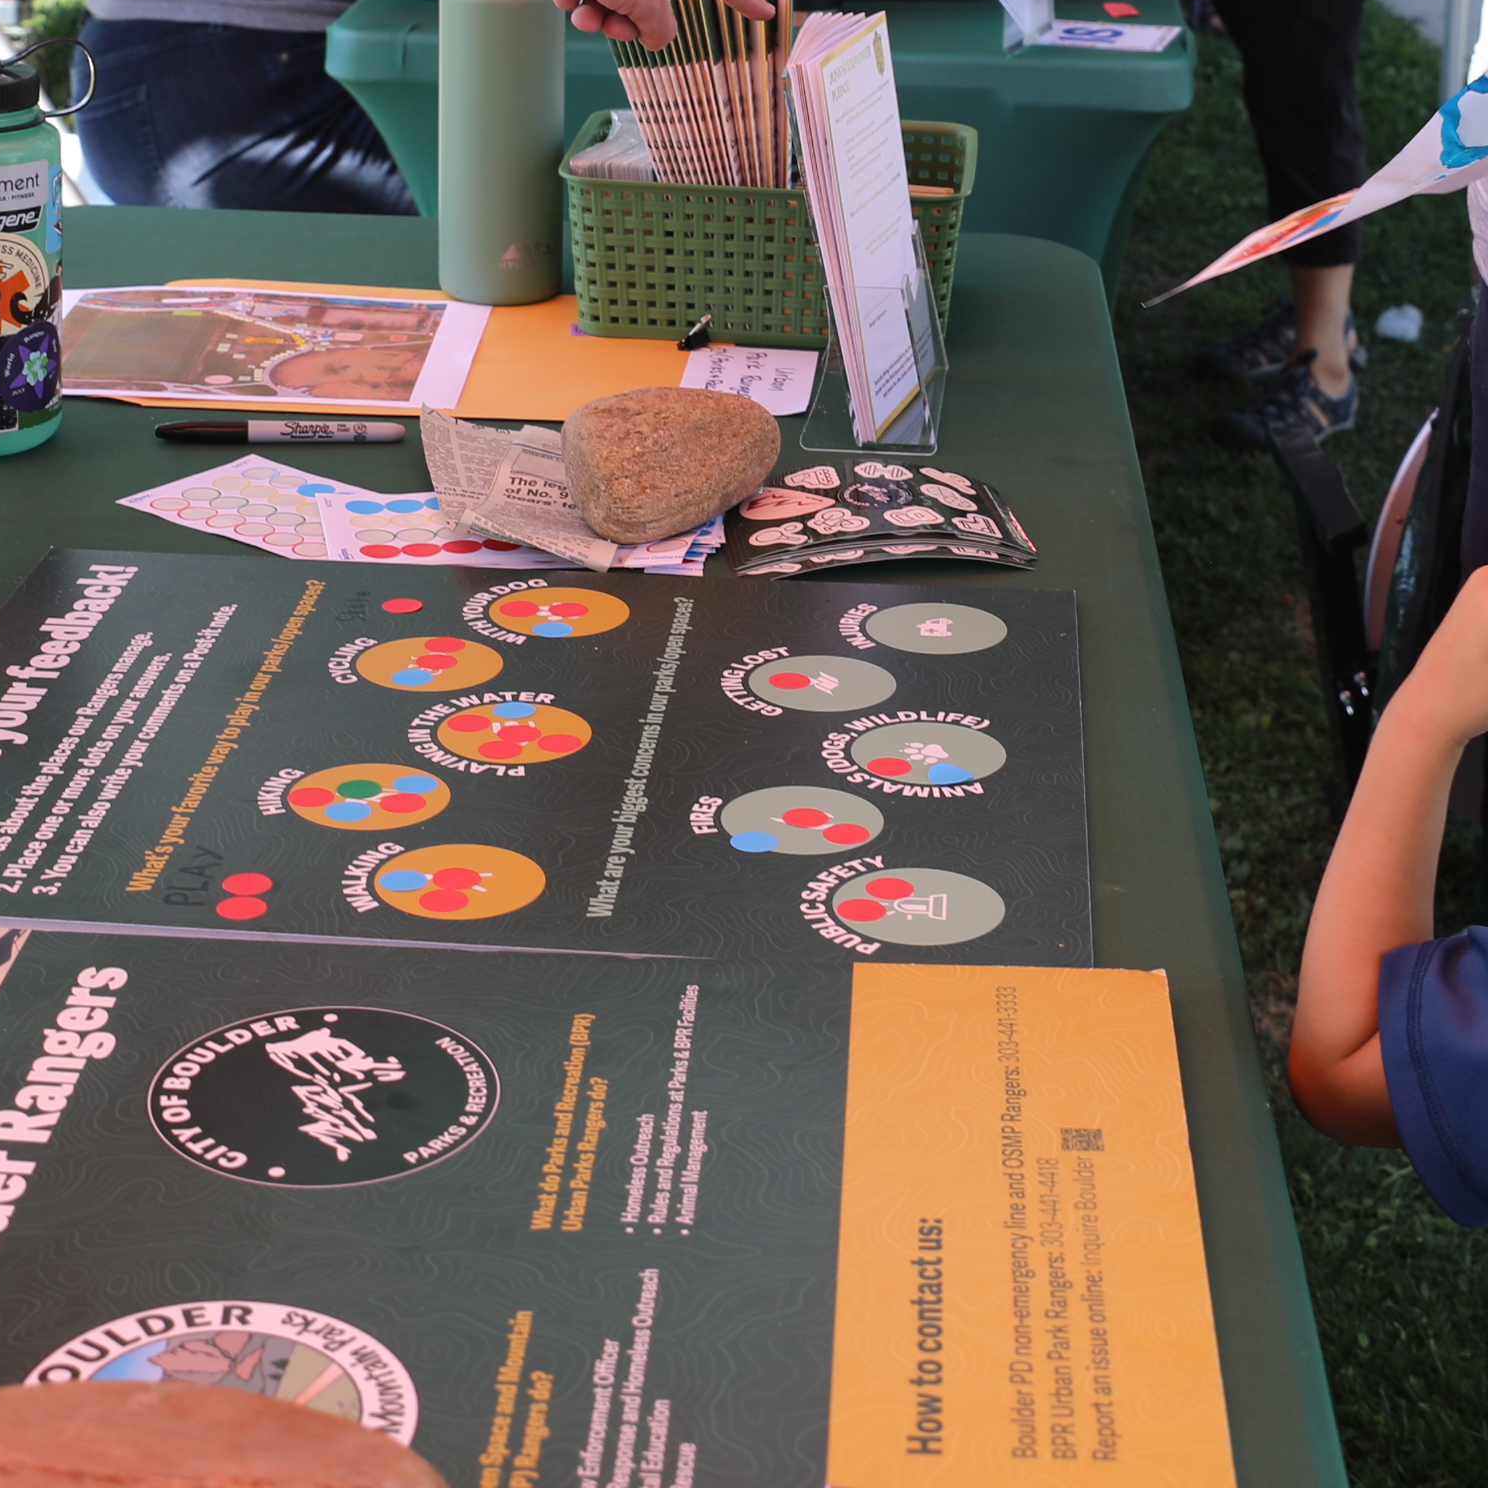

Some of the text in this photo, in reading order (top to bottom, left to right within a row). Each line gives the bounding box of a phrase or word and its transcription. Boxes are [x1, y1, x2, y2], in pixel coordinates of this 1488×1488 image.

[15, 248, 42, 290] MEDICINE
[505, 487, 570, 500] of No. 9
[509, 476, 538, 489] The
[462, 592, 498, 621] YOUR
[489, 578, 548, 596] DOG
[5, 563, 139, 679] feedback!
[468, 619, 527, 645] WITH
[838, 603, 878, 650] INJURIES
[111, 631, 154, 673] manage.
[328, 637, 379, 684] CYCLING
[75, 672, 124, 716] Rangers
[128, 652, 173, 699] answers.
[720, 646, 790, 717] GETTING LOST
[67, 715, 94, 736] our
[100, 724, 125, 740] on
[110, 698, 141, 725] your
[843, 710, 991, 733] WILDLIFE)
[31, 603, 238, 896] 3. You can also write your comments on a Post-it note.
[38, 736, 80, 775] places
[77, 740, 114, 767] dots
[124, 578, 326, 892] What's your favorite way to play in our parks/open spaces?
[407, 691, 556, 777] PLAYING IN THE WATER
[585, 596, 695, 918] What are your biggest concerns in our parks/open spaces?
[20, 774, 54, 796] the
[60, 767, 96, 799] more
[256, 767, 305, 816] HIKING
[846, 771, 985, 798] ANIMALS
[34, 815, 64, 840] one
[50, 799, 74, 815] or
[689, 795, 724, 835] FIRES
[1, 840, 48, 878] Place
[163, 845, 224, 907] PLAY
[341, 842, 406, 913] WALKING
[799, 855, 885, 956] PUBLIC SAFETY
[159, 1015, 302, 1169] CITY OF BOULDER
[402, 1036, 489, 1165] PARKS & RECREATION
[530, 1013, 596, 1230] What do Parks and Recreation (BPR)
[560, 1076, 609, 1232] Urban Parks Rangers do?
[994, 985, 1038, 1459] Boulder PD non-emergency line and OSMP Rangers: 303-441-3333
[1035, 1157, 1078, 1460] BPR Urban Park Rangers: 303-441-4418
[1071, 1154, 1121, 1461] Report an issue online: Inquire Boulder
[281, 1310, 358, 1354] Parks
[906, 1217, 943, 1455] How to contact us:
